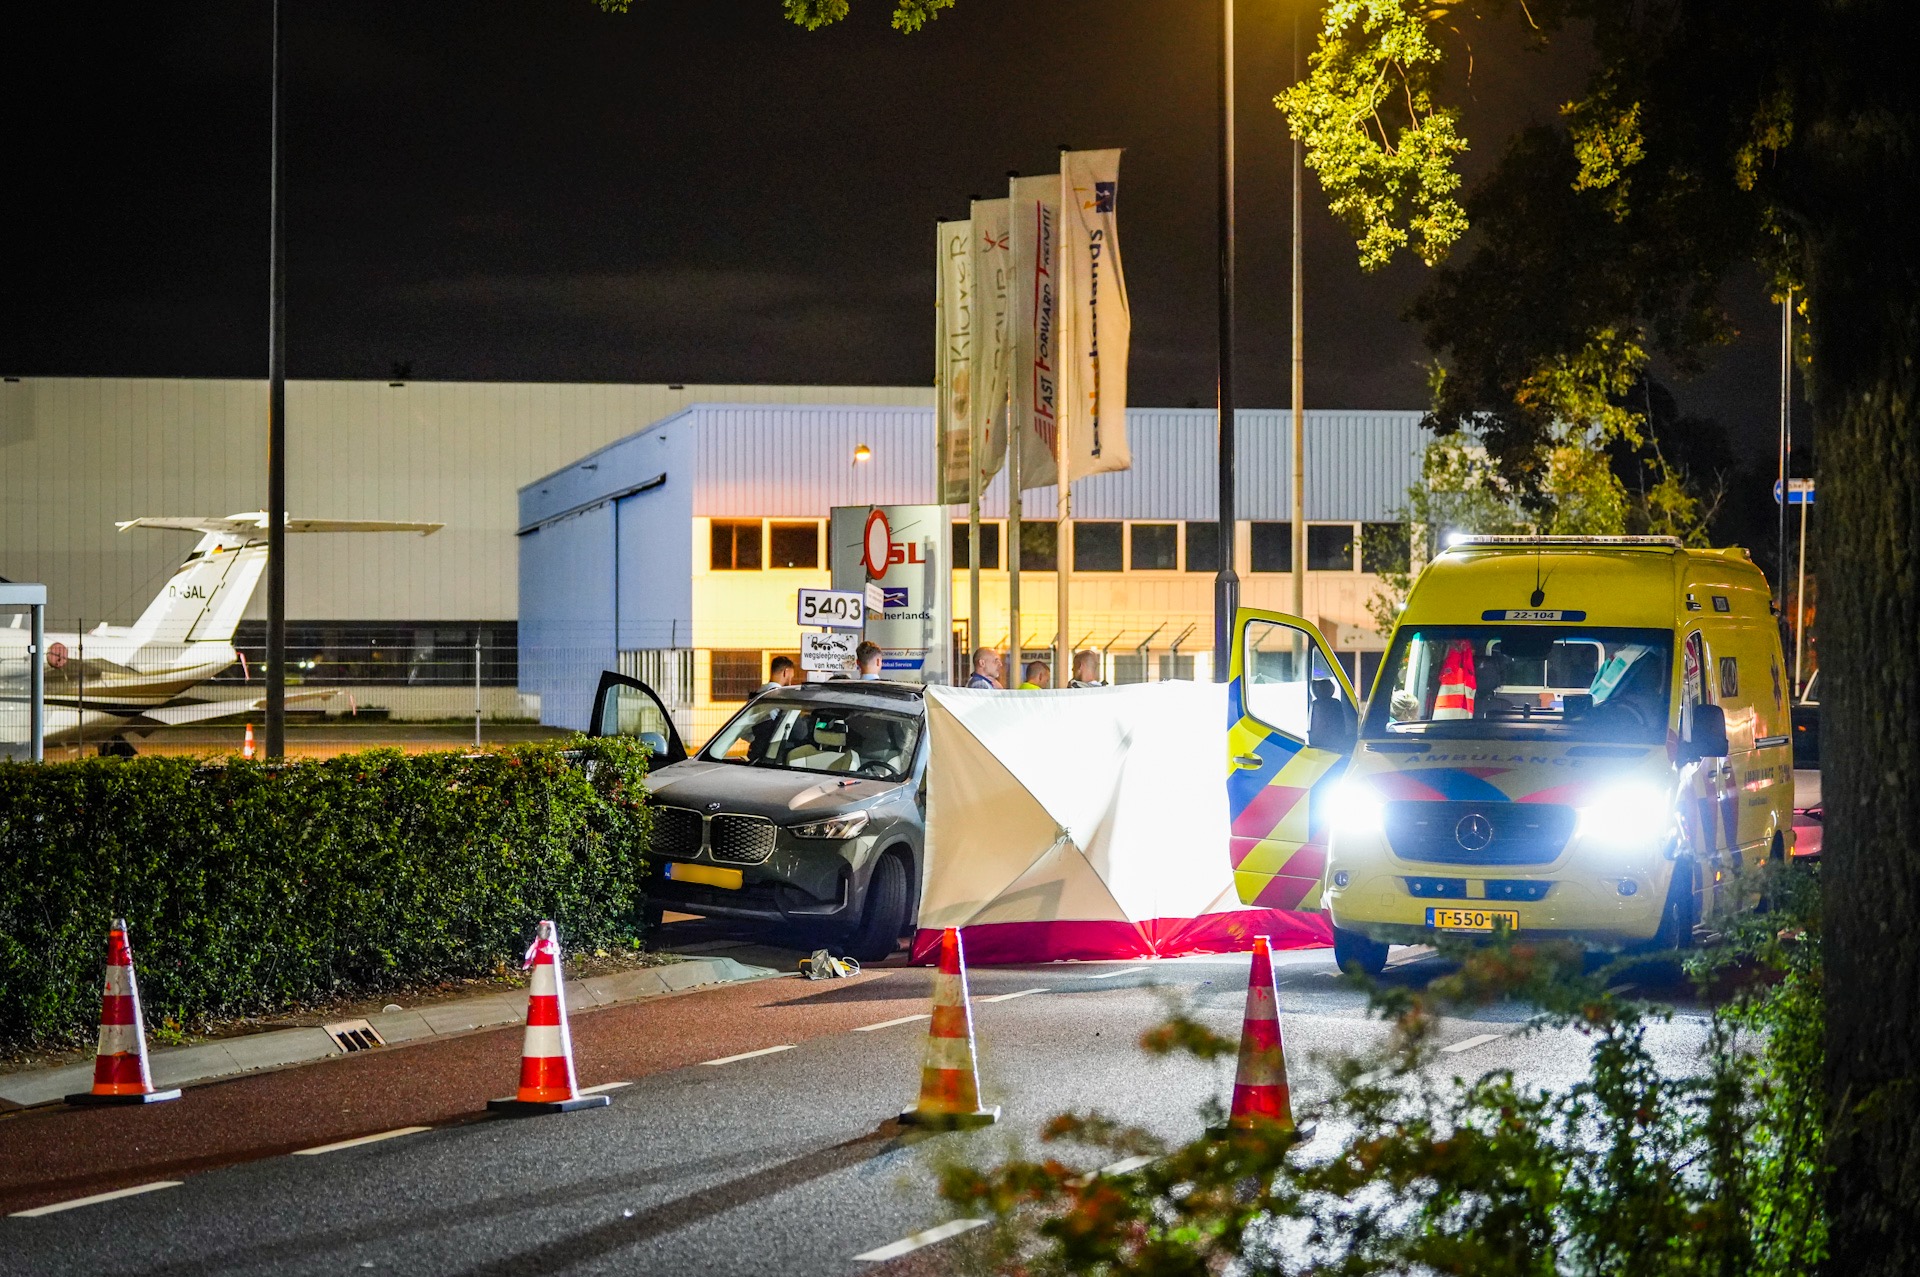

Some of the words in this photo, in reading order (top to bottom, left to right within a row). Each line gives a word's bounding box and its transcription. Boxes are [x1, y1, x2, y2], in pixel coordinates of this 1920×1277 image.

[860, 542, 926, 565] SL
[804, 596, 861, 620] 5403
[1513, 611, 1554, 619] 22-104
[1404, 754, 1585, 768] AMBULANCE
